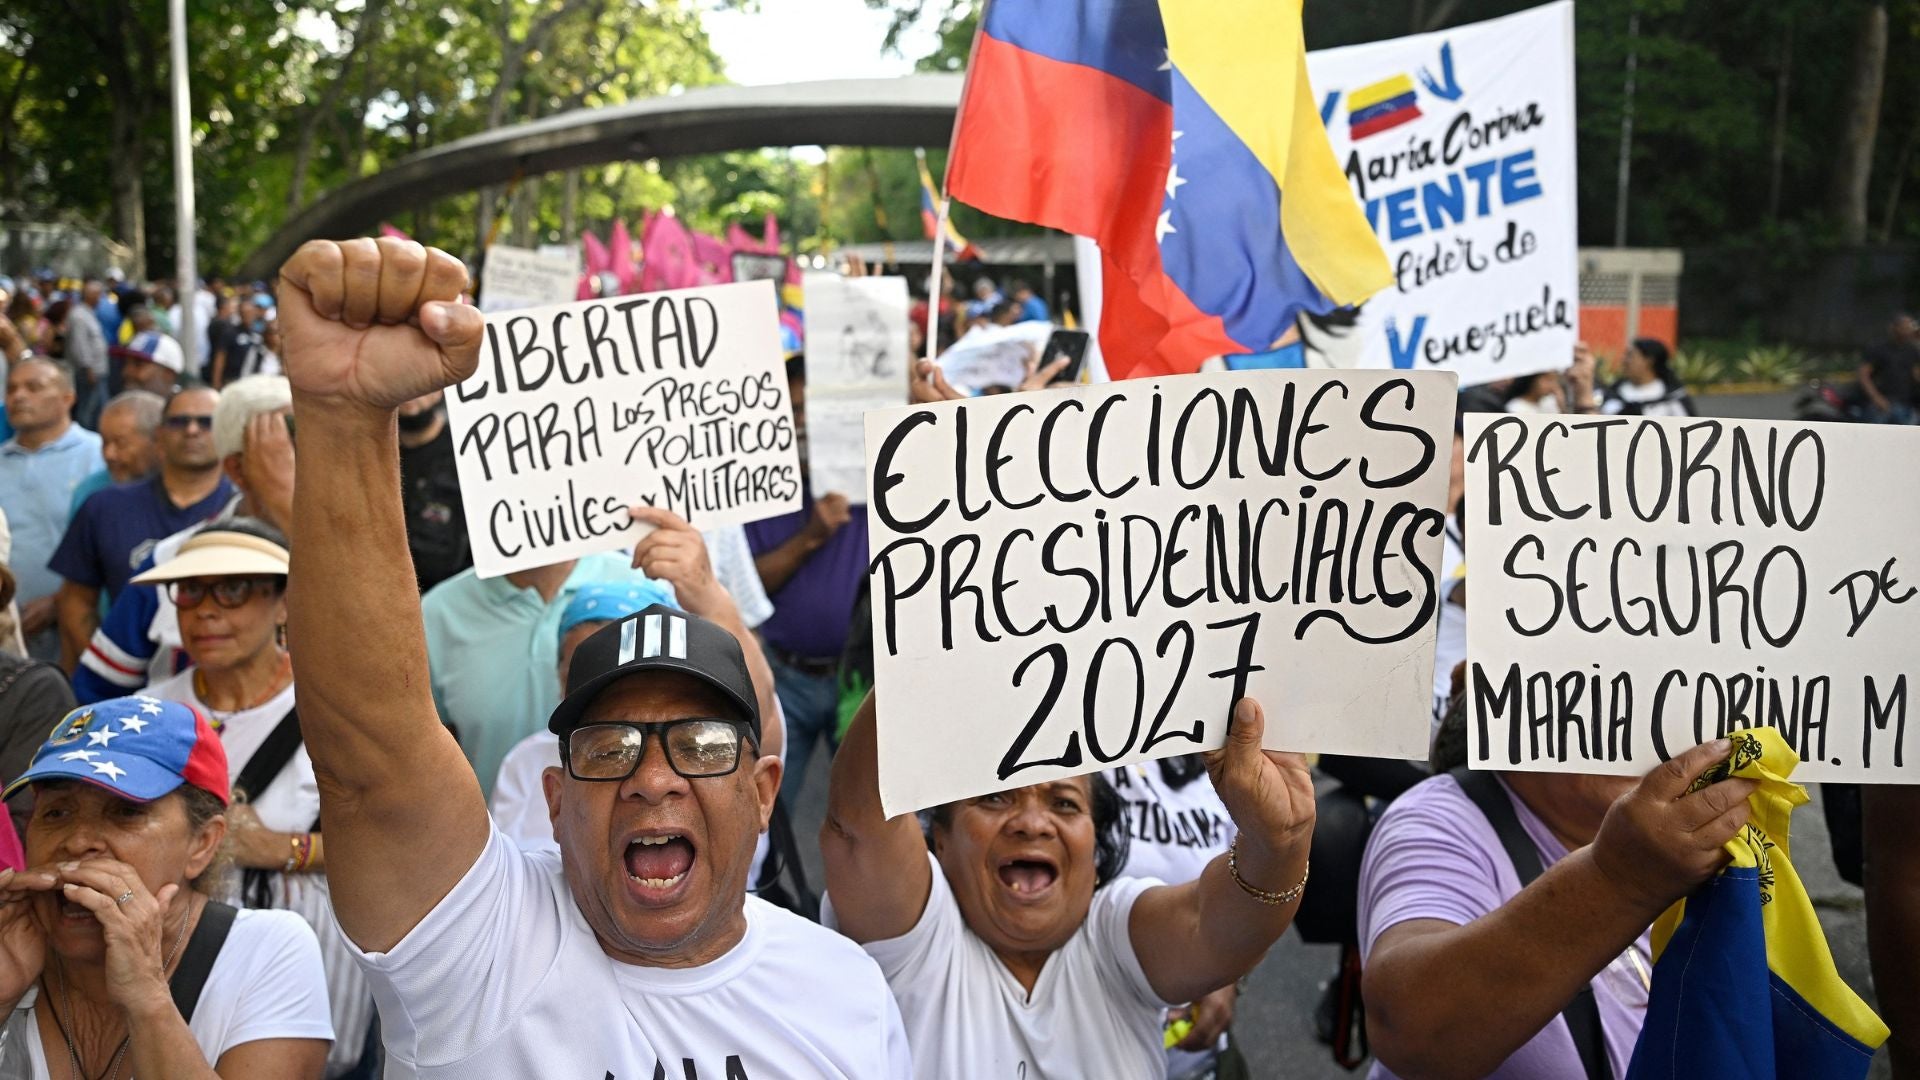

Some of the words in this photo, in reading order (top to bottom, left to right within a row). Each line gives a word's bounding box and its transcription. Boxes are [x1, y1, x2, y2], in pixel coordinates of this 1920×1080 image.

[1442, 102, 1545, 165] Corina
[1494, 221, 1537, 263] de
[1385, 284, 1572, 369] Venezuela
[459, 396, 602, 481] PARA
[641, 371, 782, 423] PRESOS
[873, 378, 1437, 534] ELECCIONES
[1466, 416, 1826, 532] RETORNO
[870, 485, 1445, 656] PRESIDENCIALES
[1503, 534, 1808, 650] SEGURO
[1828, 556, 1919, 638] DE
[996, 612, 1265, 781] 2027
[1472, 662, 1633, 765] MARIA
[1863, 673, 1908, 769] M
